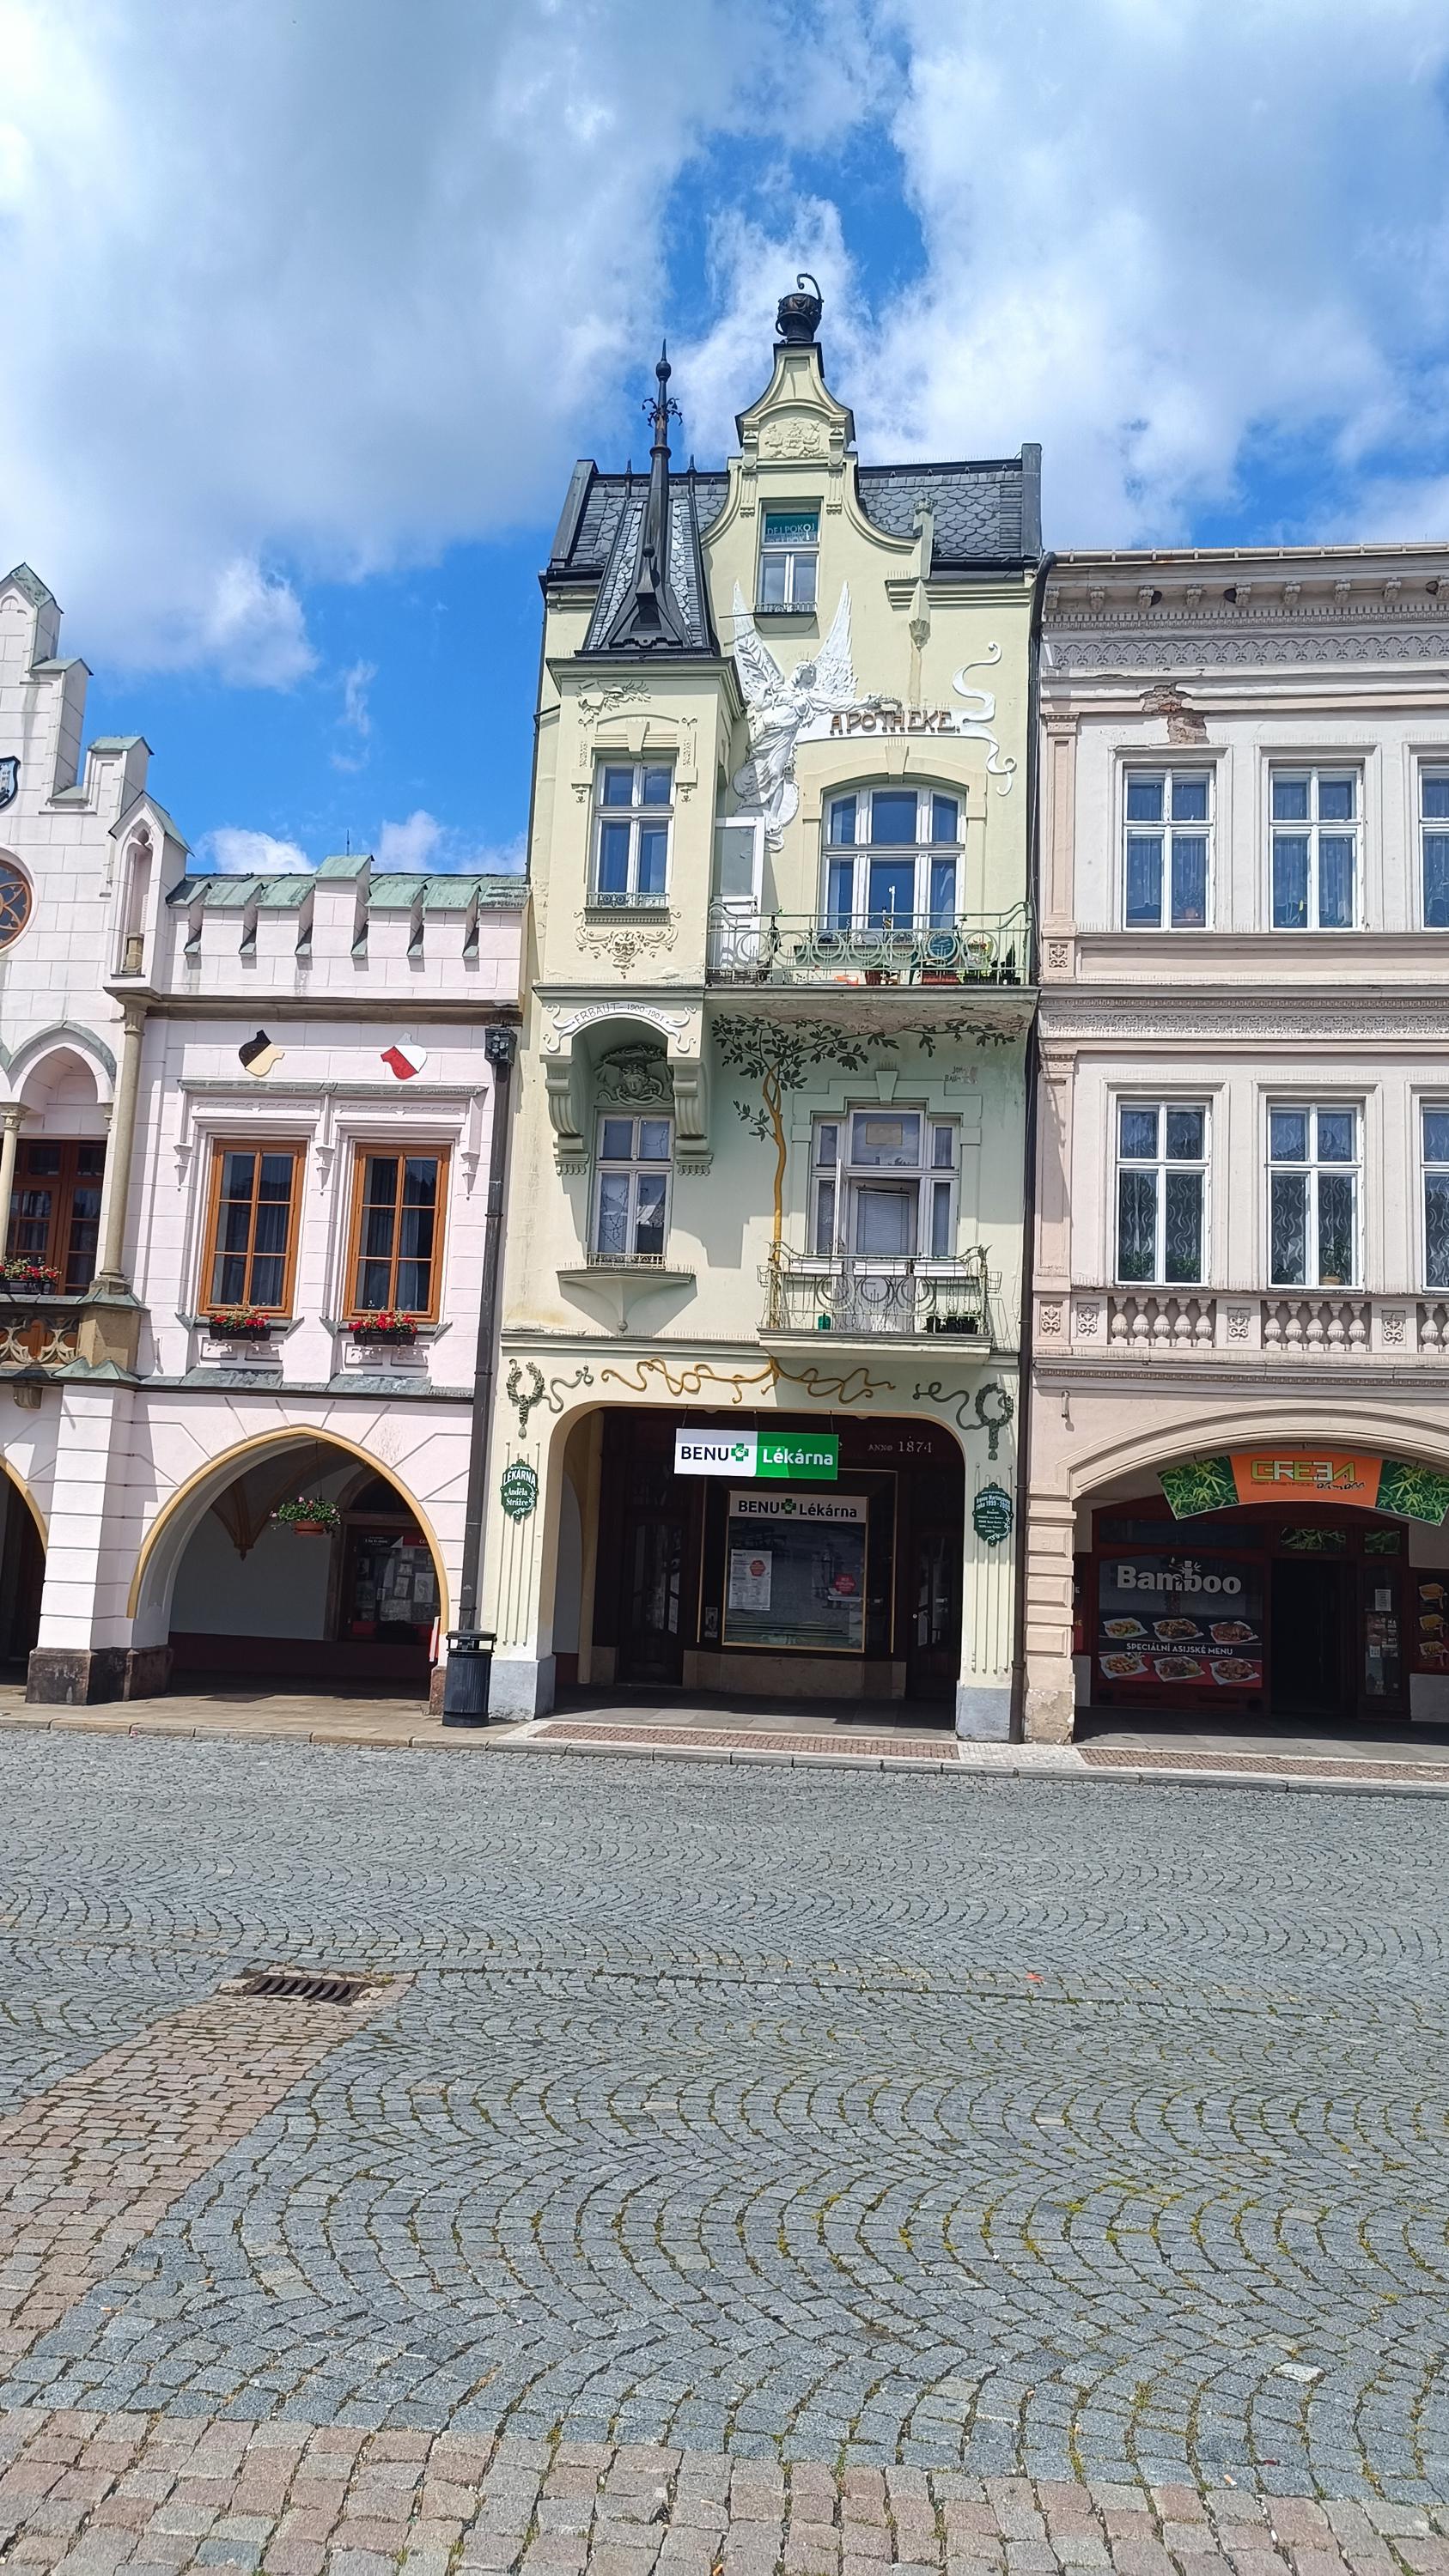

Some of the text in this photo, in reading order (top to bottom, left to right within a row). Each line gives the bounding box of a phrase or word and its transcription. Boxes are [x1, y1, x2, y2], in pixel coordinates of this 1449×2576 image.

[681, 1446, 833, 1466] BENU Lékárna
[504, 1487, 528, 1497] Anděla
[506, 1498, 528, 1506] Strážce
[738, 1500, 857, 1517] BENU Lékárna
[1117, 1561, 1242, 1594] Bamboo
[1126, 1643, 1233, 1656] SPECIÁLNÍ ASIJSKÉ MENU
